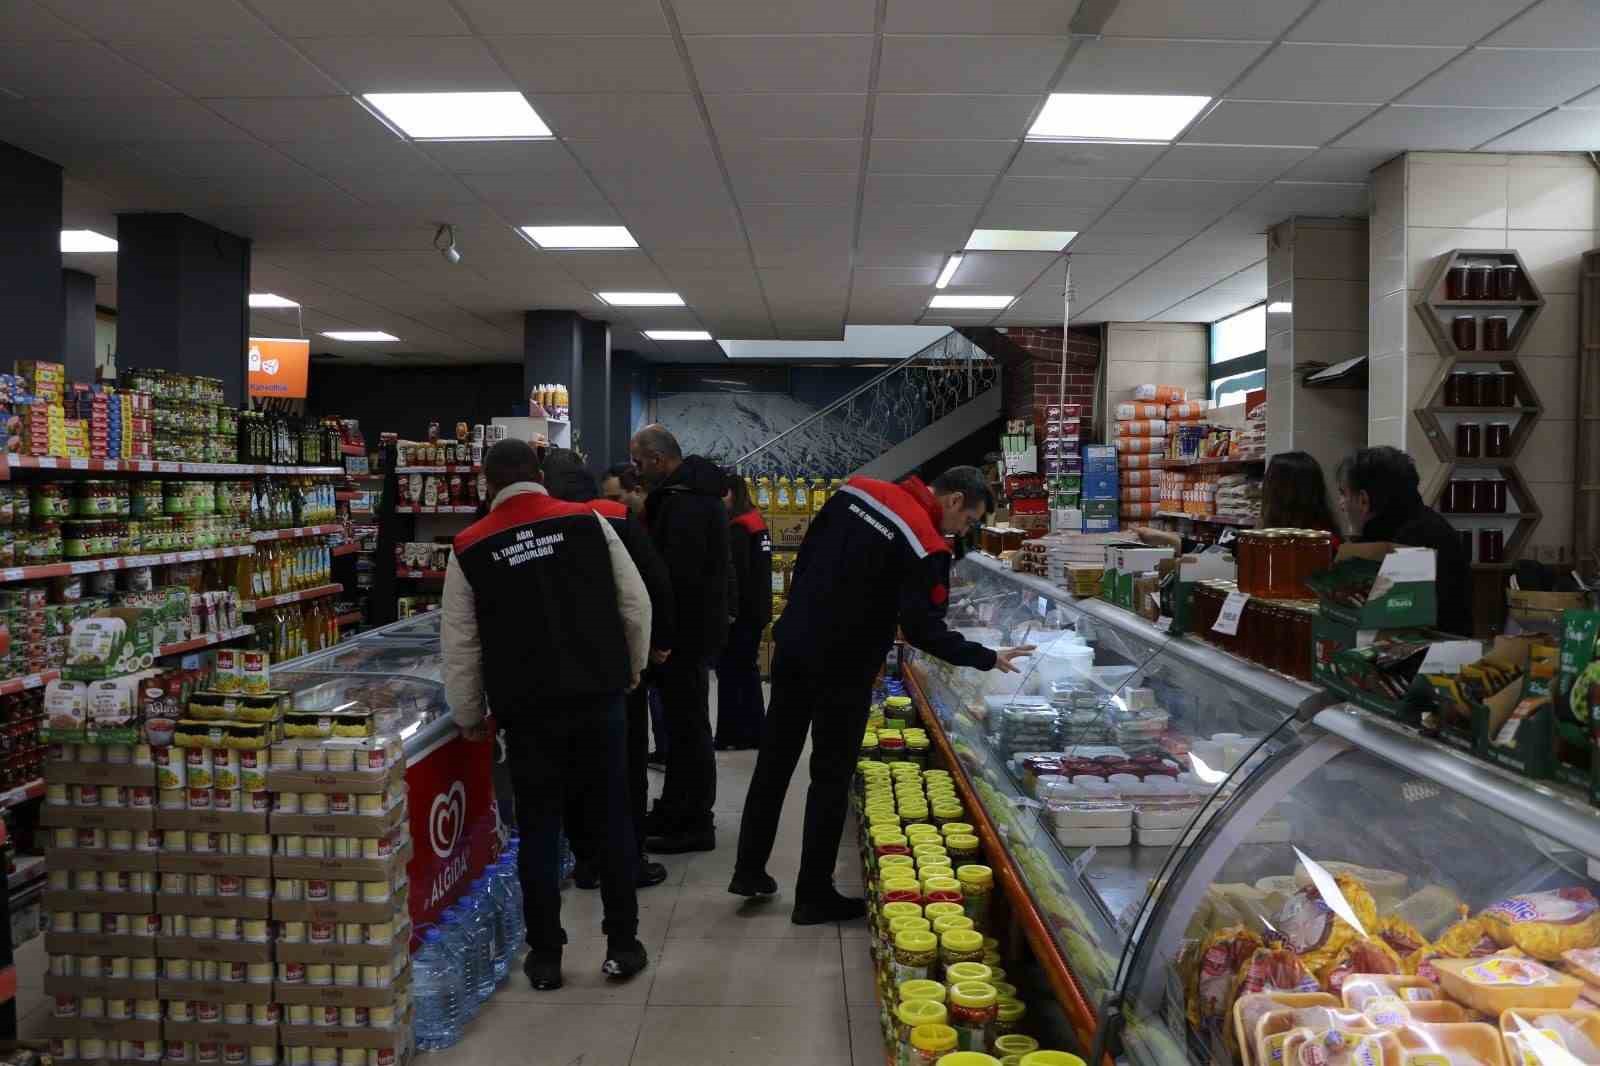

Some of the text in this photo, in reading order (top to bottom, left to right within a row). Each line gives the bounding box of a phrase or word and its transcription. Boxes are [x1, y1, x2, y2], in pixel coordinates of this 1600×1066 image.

[499, 543, 525, 557] TARIM
[525, 540, 535, 549] VE
[535, 532, 564, 546] ORMAN
[516, 528, 534, 541] AĞRI
[508, 544, 554, 567] MÜDÜRLÜĞÜ
